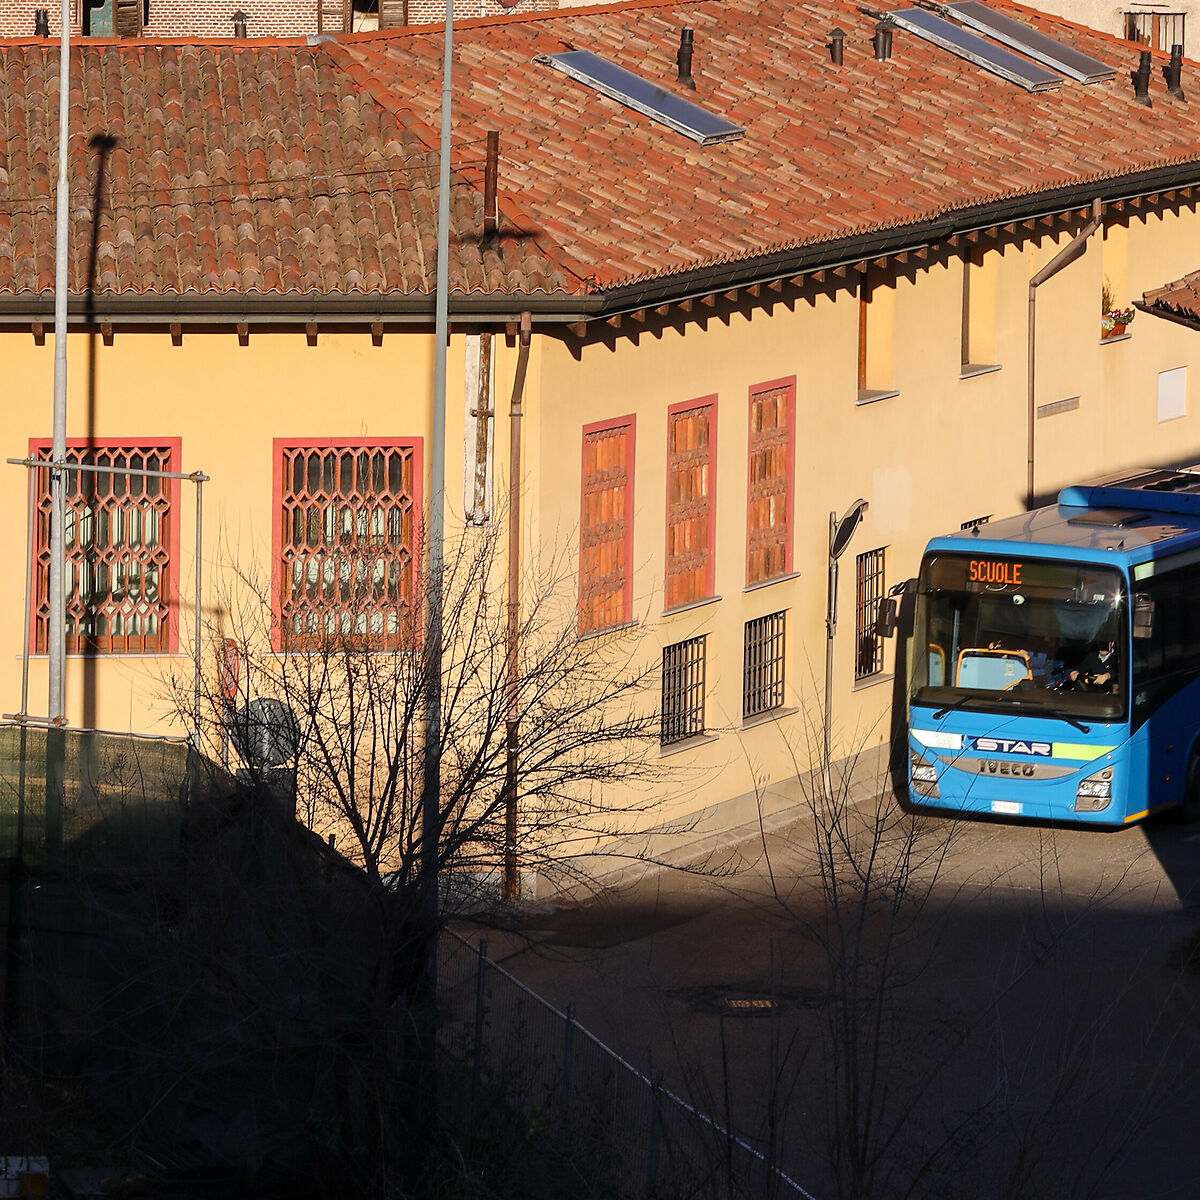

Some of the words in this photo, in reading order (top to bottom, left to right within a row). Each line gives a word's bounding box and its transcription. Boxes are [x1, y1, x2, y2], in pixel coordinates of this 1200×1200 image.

[969, 560, 1023, 585] SCUOLE
[976, 737, 1052, 756] STAR
[979, 759, 1036, 777] IVECO
